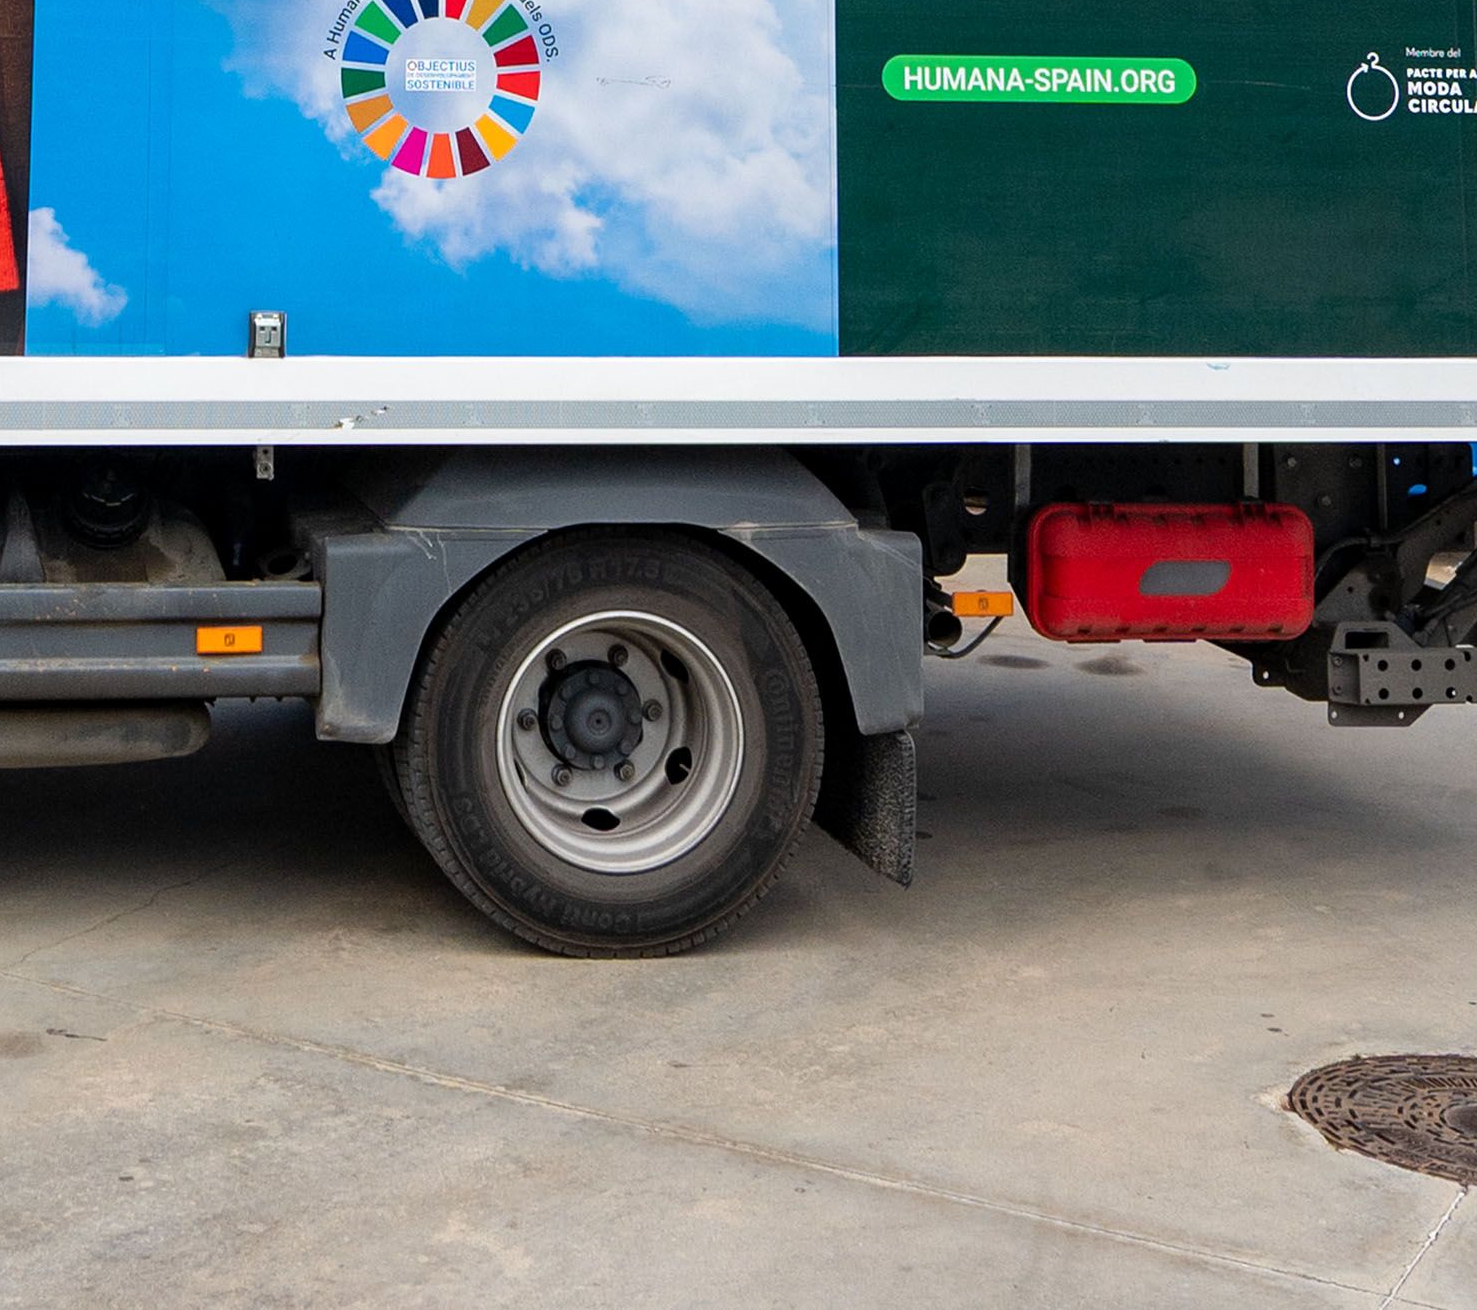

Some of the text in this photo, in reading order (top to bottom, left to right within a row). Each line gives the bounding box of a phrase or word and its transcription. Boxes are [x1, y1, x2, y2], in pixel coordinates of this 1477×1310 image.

[324, 48, 336, 60] A
[539, 23, 559, 62] ODS.
[1405, 47, 1461, 58] Membre del
[407, 61, 475, 71] OBJECTIUS
[1407, 68, 1443, 78] PACTE
[1445, 68, 1466, 78] PER
[1469, 69, 1477, 79] A
[407, 80, 475, 89] SOSTENIBLE
[904, 66, 1176, 93] HUMANA-SPAIN.ORG
[1408, 82, 1462, 96] MODA
